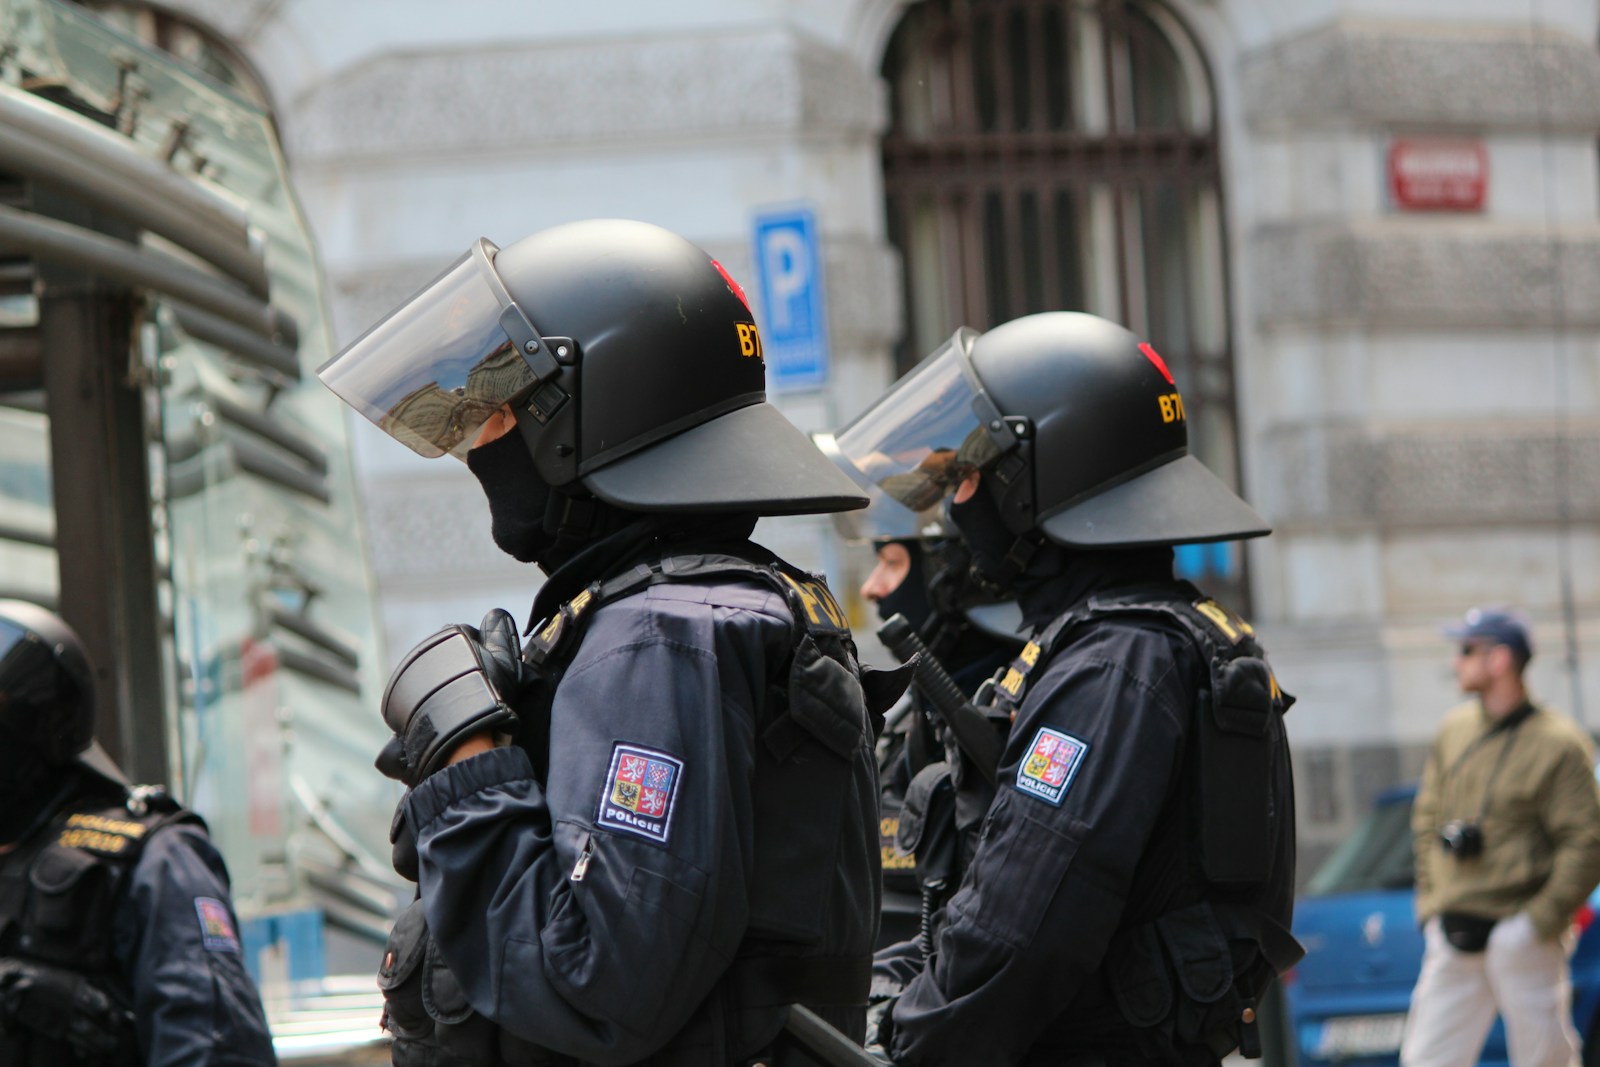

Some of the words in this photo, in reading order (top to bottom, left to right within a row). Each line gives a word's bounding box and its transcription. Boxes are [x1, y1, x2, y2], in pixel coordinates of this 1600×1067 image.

[766, 227, 809, 330] P
[1020, 775, 1058, 799] POLICIE
[605, 808, 661, 834] POLICIE
